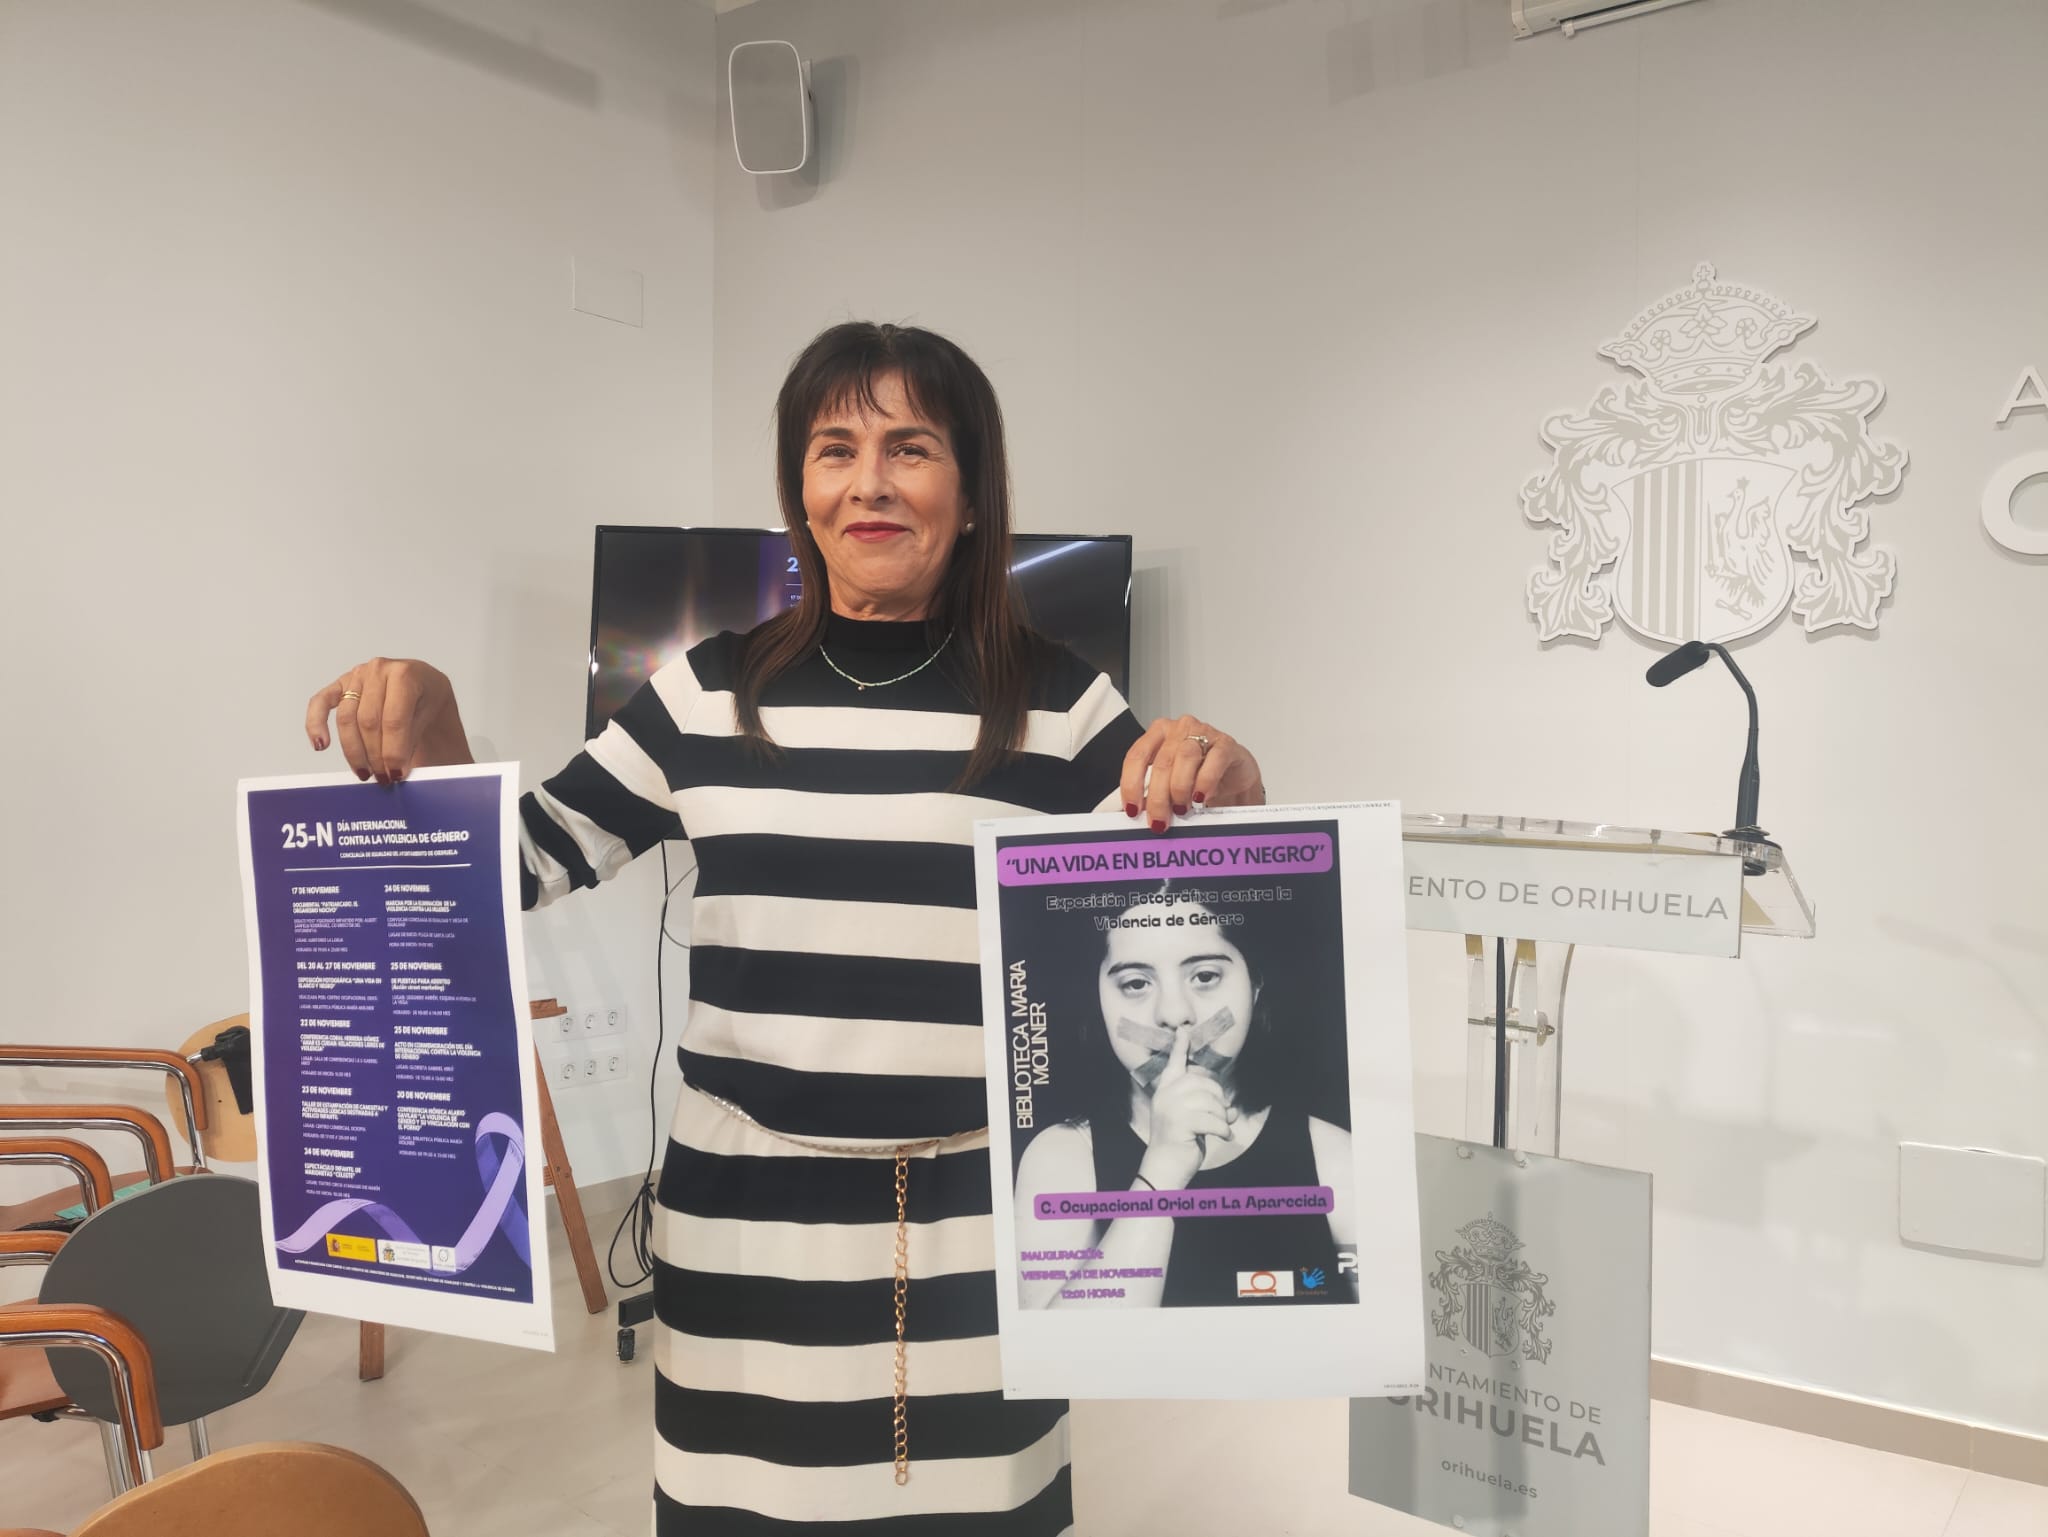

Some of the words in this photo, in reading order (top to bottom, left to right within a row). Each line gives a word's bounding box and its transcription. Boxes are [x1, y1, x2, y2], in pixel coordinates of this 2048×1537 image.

[337, 819, 349, 832] DÍA
[350, 819, 407, 831] INTERNACIONAL
[281, 821, 333, 849] 25-N
[338, 834, 372, 846] CONTRA
[373, 834, 382, 845] LA
[383, 833, 418, 845] VIOLENCIA
[419, 832, 430, 843] DE
[430, 830, 469, 842] GÉNERO
[1005, 856, 1060, 876] “UNA
[1065, 853, 1109, 873] VIDA
[1113, 851, 1139, 871] EN
[1142, 848, 1225, 869] BLANCO
[1227, 847, 1243, 865] Y
[1244, 843, 1326, 865] NEGRO”
[299, 886, 306, 894] DE
[307, 886, 339, 894] NOVIEMBRE
[393, 884, 400, 892] DE
[401, 884, 430, 893] NOVIEMBRE
[1046, 893, 1126, 912] Exposición
[1221, 887, 1273, 902] contra
[1276, 886, 1292, 900] la
[1499, 882, 1539, 905] DE
[1550, 885, 1729, 920] ORIHUELA
[1094, 912, 1161, 931] Violencia
[1166, 914, 1185, 927] de
[1189, 911, 1244, 926] Género
[297, 962, 308, 970] DEL
[317, 962, 324, 970] AL
[325, 962, 333, 970] 27
[334, 962, 341, 970] DE
[341, 962, 376, 970] NOVIEMBRE
[400, 962, 408, 970] DE
[408, 962, 442, 971] NOVIEMBRE
[1009, 960, 1028, 1017] MARIA
[309, 1019, 316, 1027] DE
[317, 1019, 350, 1028] NOVIEMBRE
[403, 1026, 411, 1034] DE
[412, 1027, 448, 1035] NOVIEMBRE
[1029, 1002, 1049, 1085] MOLINER
[1013, 1022, 1033, 1128] BIBLIOTECA
[310, 1086, 318, 1094] DE
[318, 1086, 352, 1096] NOVIEMBRE
[406, 1091, 413, 1099] DE
[414, 1092, 451, 1101] NOVIEMBRE
[312, 1148, 320, 1156] DE
[320, 1148, 354, 1158] NOVIEMBRE
[1040, 1201, 1056, 1215] C.
[1060, 1198, 1153, 1216] Ocupacional
[1157, 1197, 1194, 1211] Oriol
[1198, 1198, 1217, 1210] en
[1221, 1195, 1241, 1209] La
[1245, 1194, 1327, 1211] Aparecida
[1084, 1269, 1099, 1280] DE
[1087, 1288, 1125, 1298] HORAS
[1570, 1401, 1601, 1425] DE
[1441, 1459, 1538, 1500] orihuela.es
